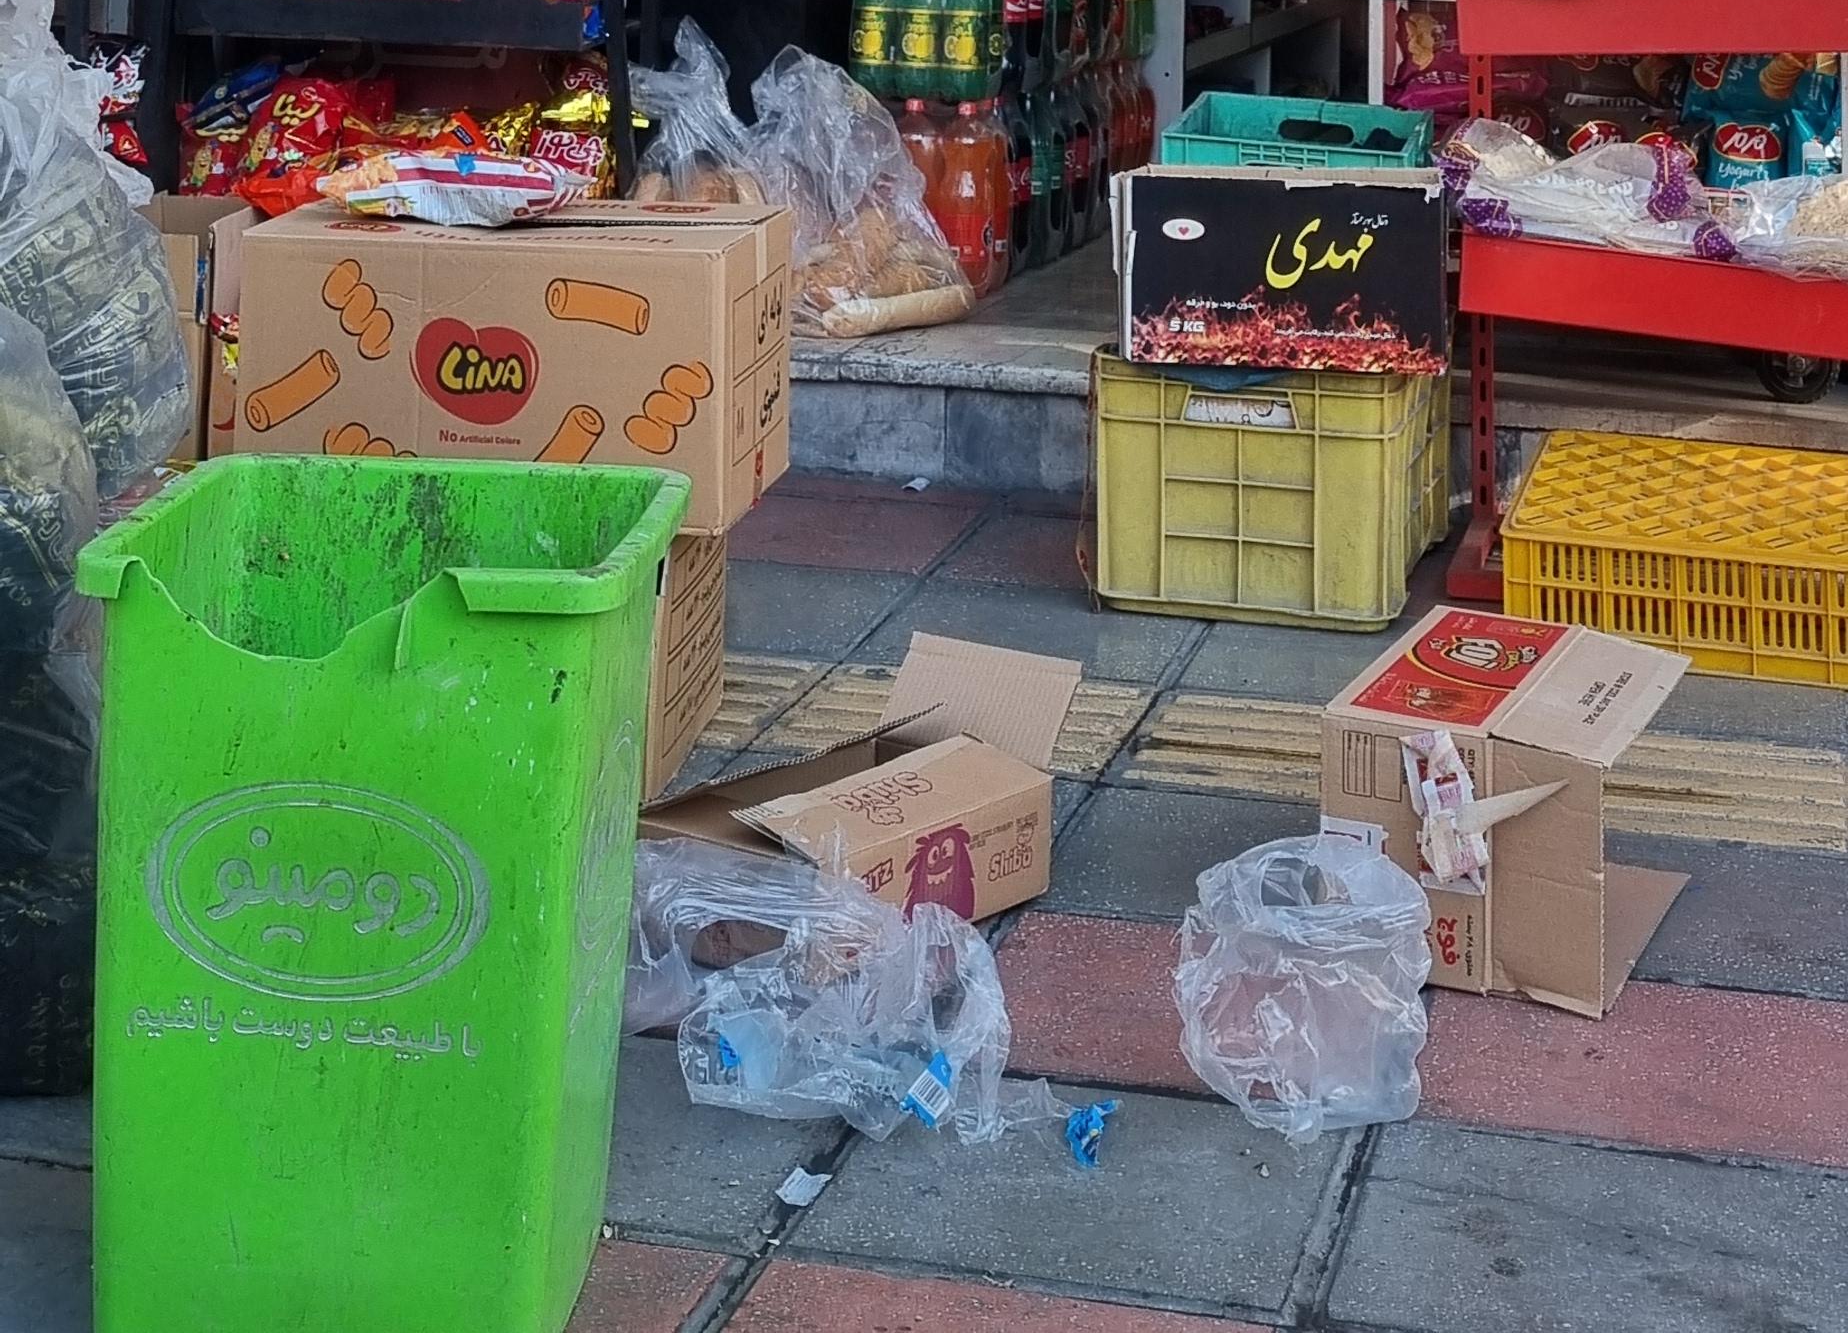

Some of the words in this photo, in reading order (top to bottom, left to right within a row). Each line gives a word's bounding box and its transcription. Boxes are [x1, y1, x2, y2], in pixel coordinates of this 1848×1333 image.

[1265, 217, 1375, 290] مهدی
[1168, 319, 1182, 332] 5
[1182, 320, 1206, 333] KG
[438, 428, 459, 444] No
[205, 825, 441, 945] دومینو
[1436, 917, 1461, 966] فوج
[126, 996, 226, 1043] باشیم
[231, 1005, 335, 1050] دوست
[343, 1018, 452, 1061] طبیعت
[459, 1025, 484, 1067] با
